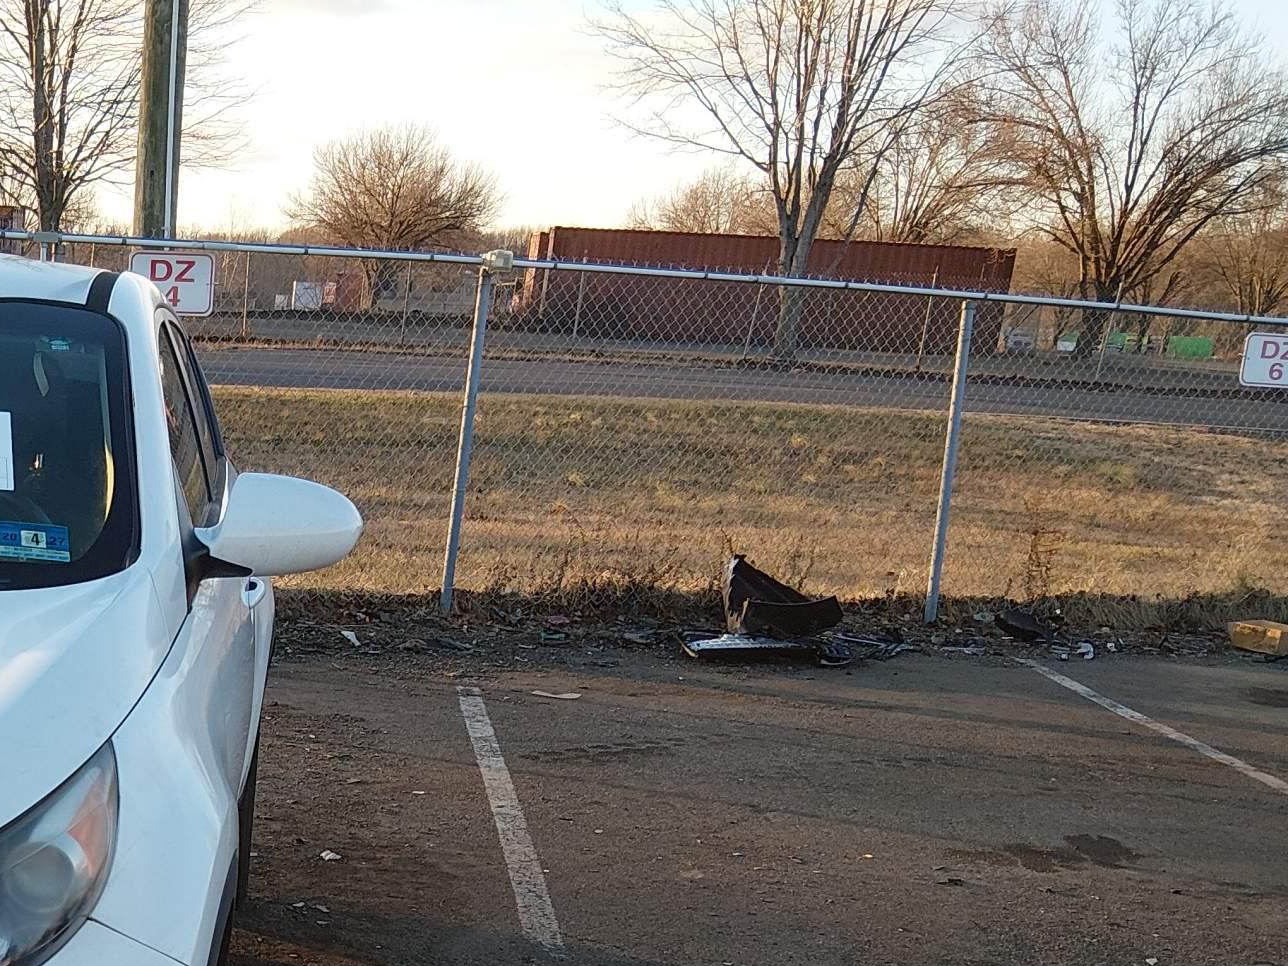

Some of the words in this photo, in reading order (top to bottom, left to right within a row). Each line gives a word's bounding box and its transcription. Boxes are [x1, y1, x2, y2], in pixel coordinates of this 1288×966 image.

[150, 259, 196, 283] DZ
[165, 285, 181, 307] 4
[1269, 362, 1284, 381] 6
[31, 533, 41, 546] 4
